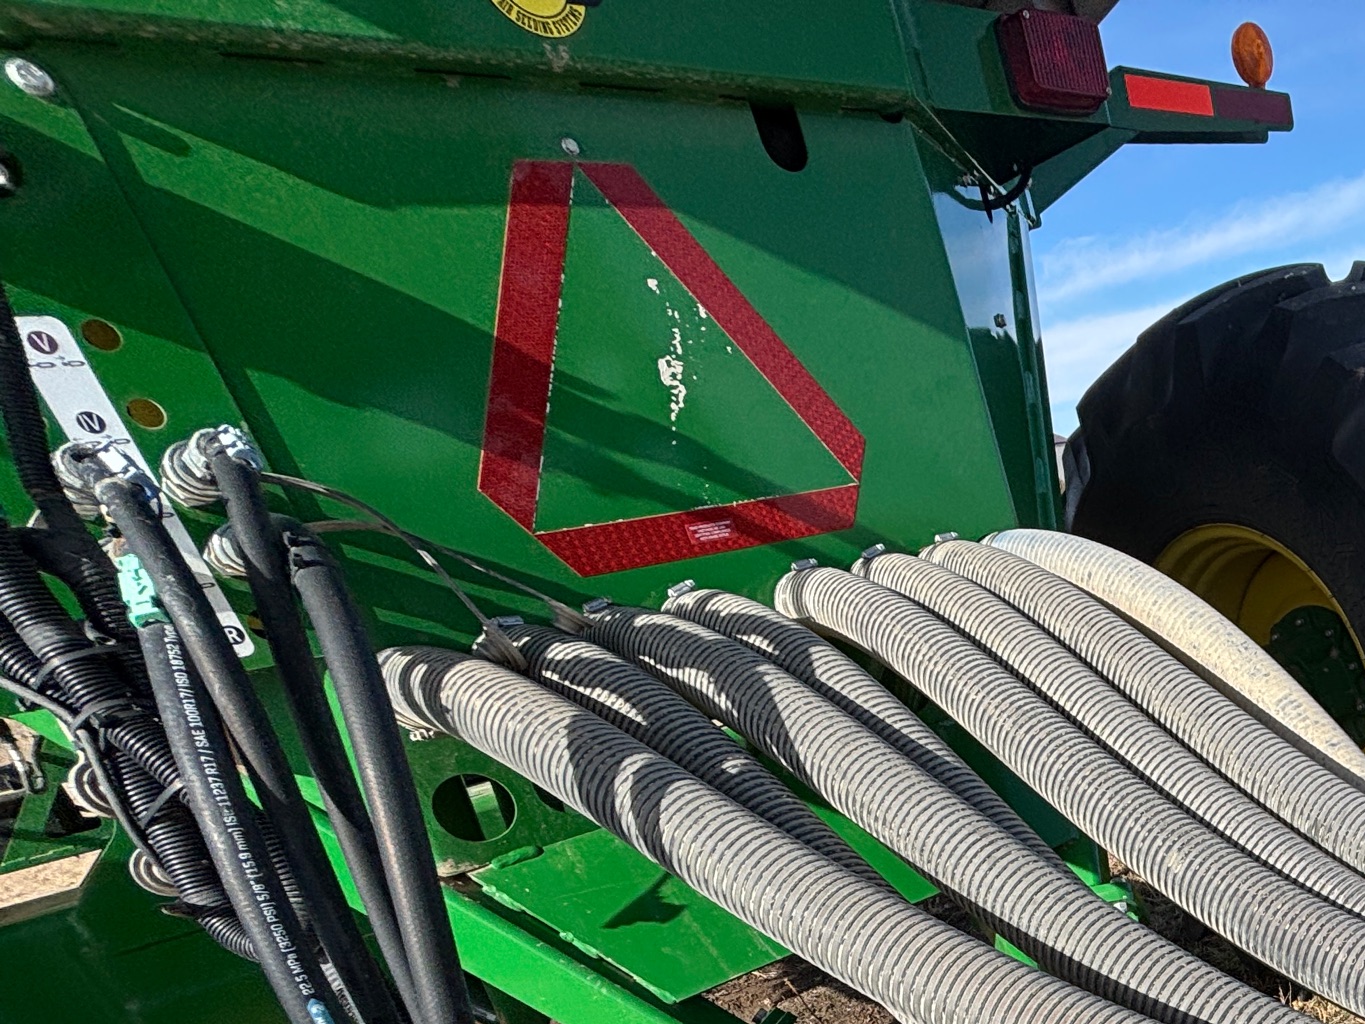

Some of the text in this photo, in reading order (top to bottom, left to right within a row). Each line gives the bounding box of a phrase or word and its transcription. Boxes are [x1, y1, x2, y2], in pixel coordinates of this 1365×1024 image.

[515, 10, 554, 35] SEEDING
[165, 643, 185, 670] 18752
[191, 729, 209, 747] SAE
[199, 755, 218, 775] R17
[207, 776, 230, 807] 11237
[226, 827, 248, 851] mm)
[237, 852, 260, 879] (15.9
[259, 902, 278, 923] PSI)
[269, 923, 295, 953] (3250
[286, 953, 302, 974] MPa
[294, 974, 314, 995] 22.5
